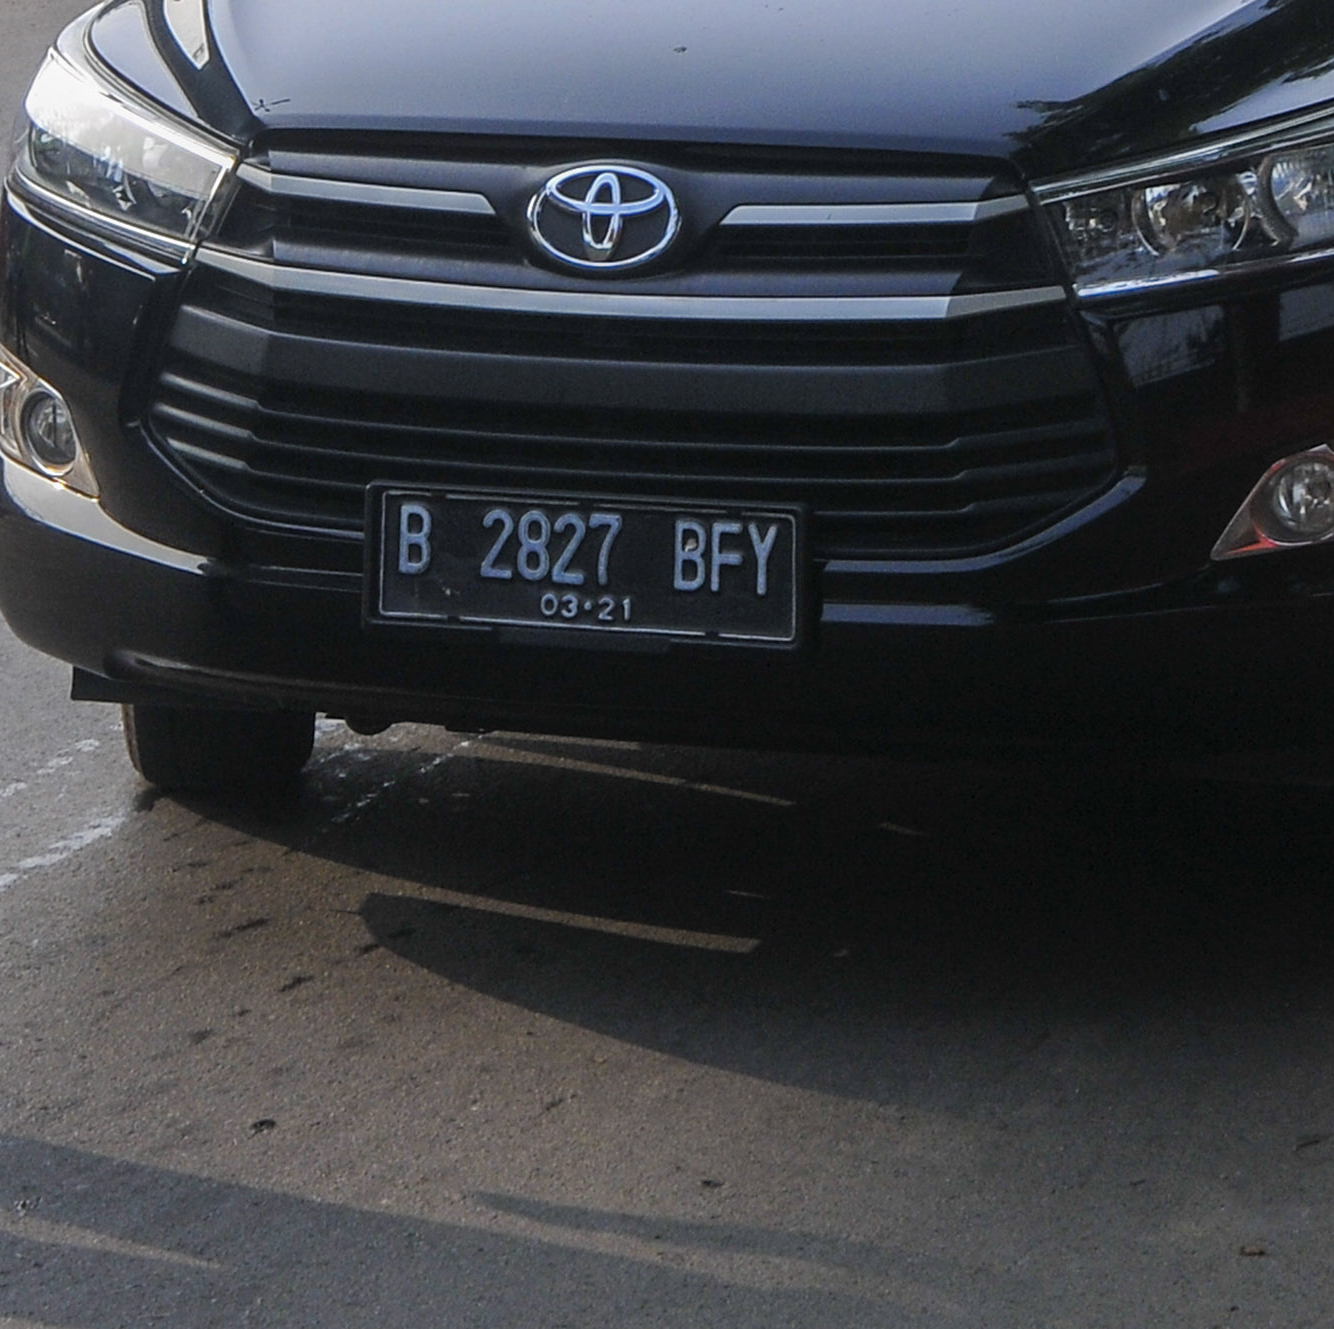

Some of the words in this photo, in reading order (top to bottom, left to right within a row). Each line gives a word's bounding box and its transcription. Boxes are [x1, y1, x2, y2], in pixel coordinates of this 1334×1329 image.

[398, 504, 432, 574] B
[480, 508, 623, 586] 2827
[673, 518, 778, 596] BFY
